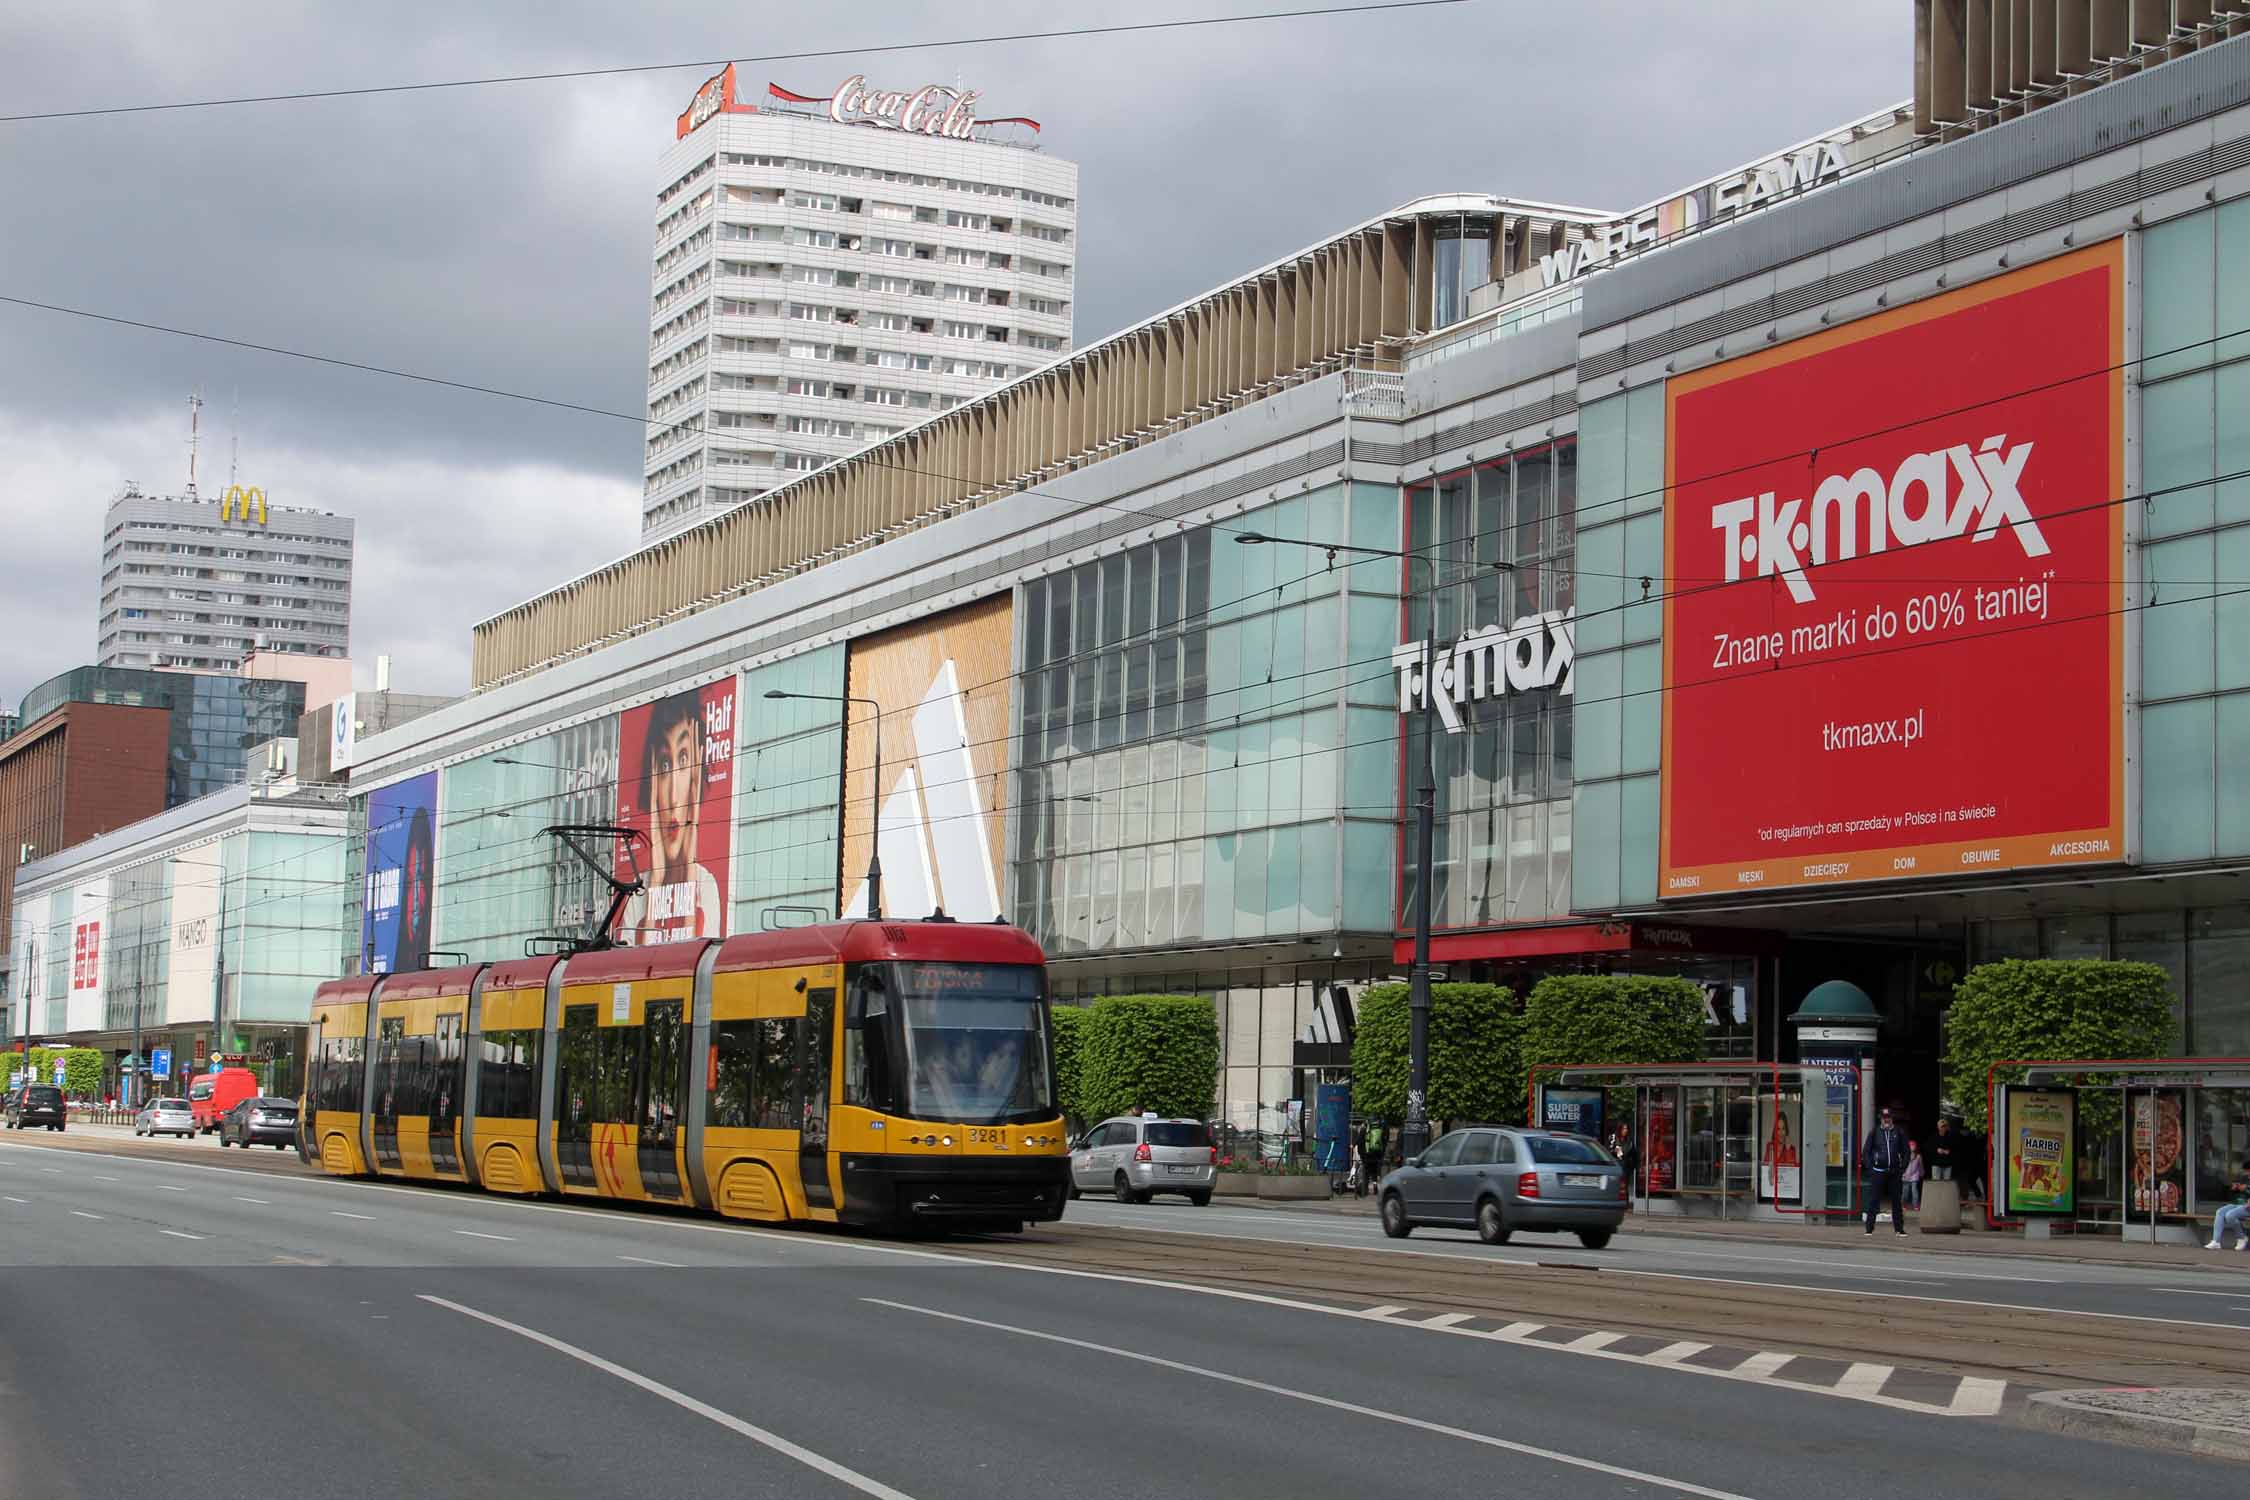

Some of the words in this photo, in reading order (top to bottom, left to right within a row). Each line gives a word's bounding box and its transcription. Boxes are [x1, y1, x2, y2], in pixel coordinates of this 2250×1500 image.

[1713, 629, 1783, 669] Znane
[1791, 609, 1857, 656] marki
[1865, 605, 1897, 641] do
[1905, 588, 1965, 634] 60%
[707, 694, 733, 735] Half
[1823, 709, 1924, 751] tkmaxx.pl
[706, 735, 731, 766] Price
[1774, 822, 1824, 842] regularnych
[1826, 822, 1843, 834] cen
[1845, 815, 1892, 832] sprzedaży
[1894, 817, 1902, 827] w
[1904, 811, 1937, 827] Polsce
[1944, 811, 1957, 822] na
[1958, 804, 1996, 821] świecie
[1669, 875, 1700, 889] DAMSKI
[1738, 870, 1764, 884] MĘSKI
[1803, 863, 1849, 878] DZIECIĘCY
[1893, 857, 1916, 869] DOM
[1961, 848, 2000, 864] OBUWIE
[2050, 839, 2110, 857] AKCESORIA
[1547, 1103, 1581, 1112] SUPER
[1547, 1111, 1581, 1121] WATER
[2025, 1138, 2061, 1151] HARIBO
